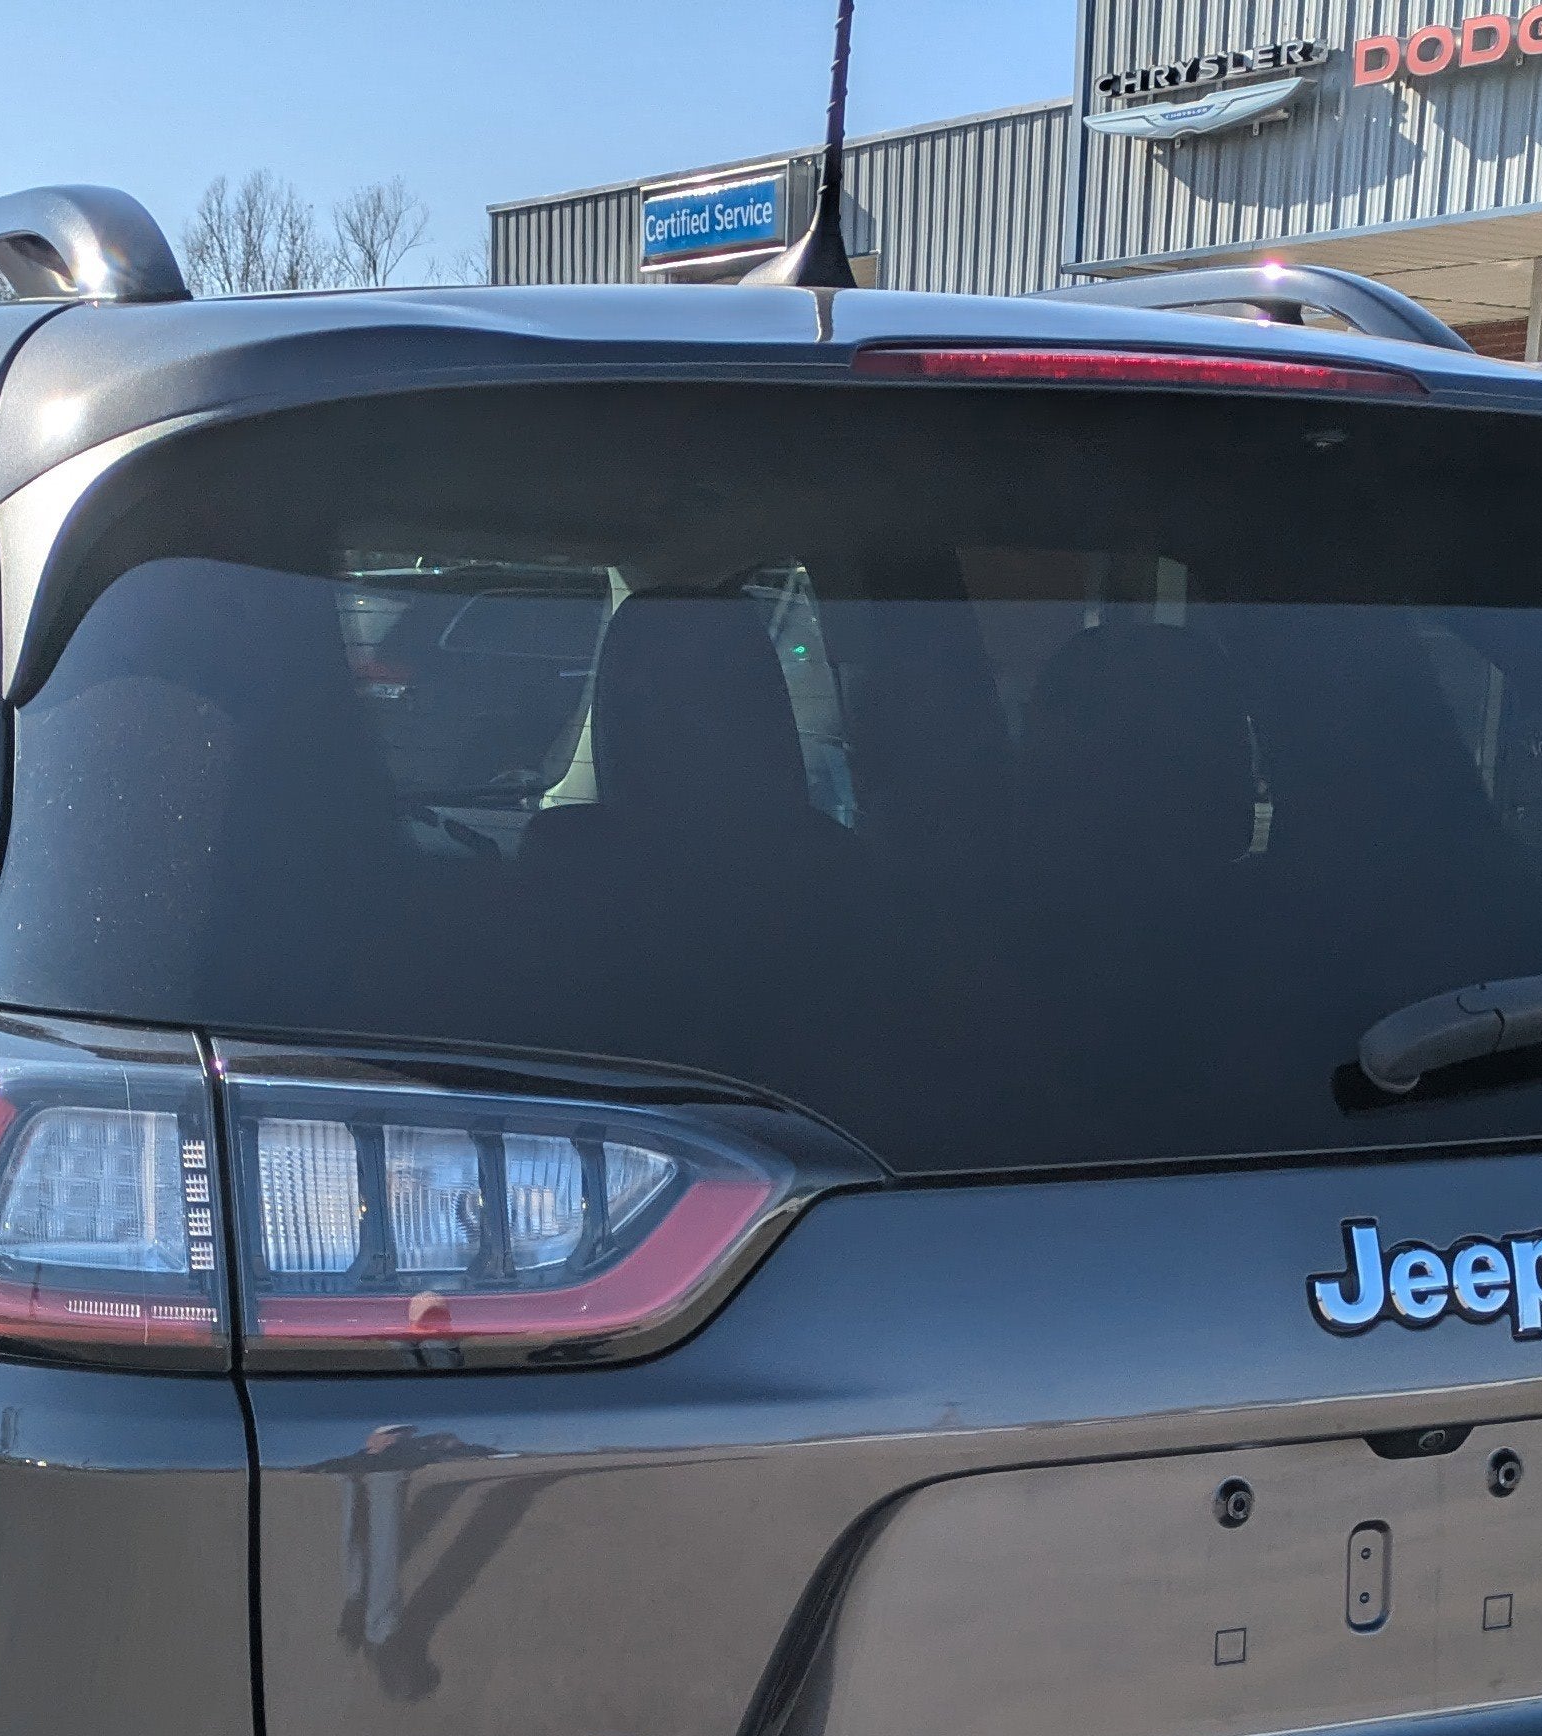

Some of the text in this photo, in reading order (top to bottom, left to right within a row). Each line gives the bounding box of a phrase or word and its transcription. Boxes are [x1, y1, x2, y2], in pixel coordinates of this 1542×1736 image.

[1093, 38, 1307, 98] CHRYSLER
[645, 197, 773, 242] Certified Service
